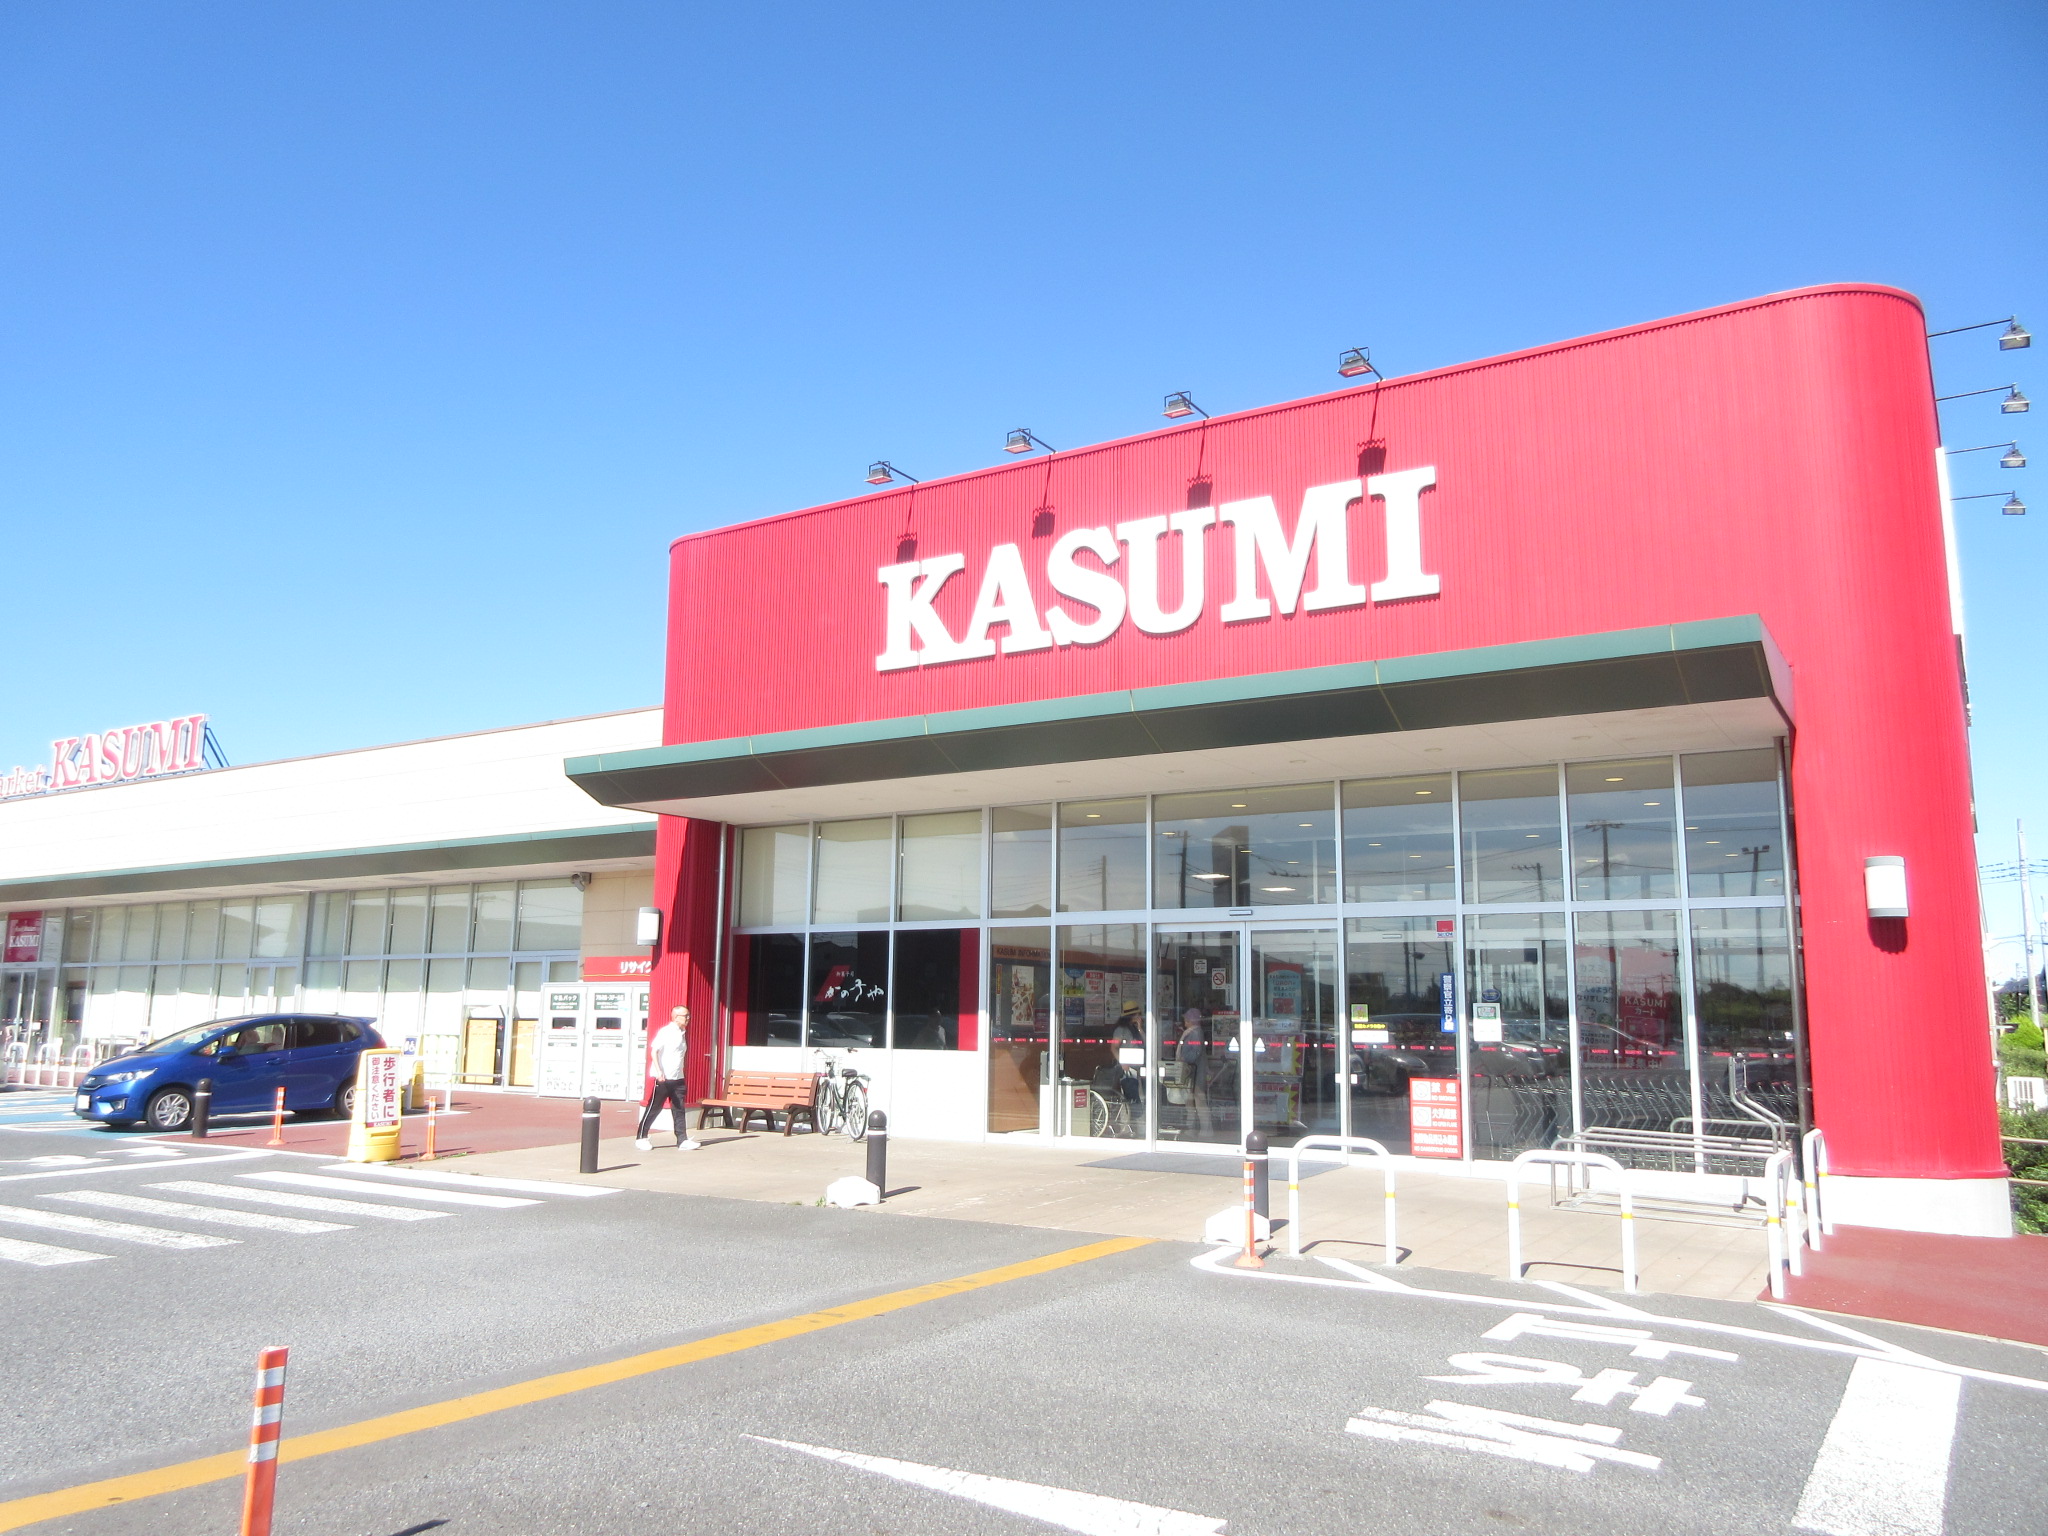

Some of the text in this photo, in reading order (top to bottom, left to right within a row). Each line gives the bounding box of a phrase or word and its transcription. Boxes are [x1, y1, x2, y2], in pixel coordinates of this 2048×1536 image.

[876, 466, 1440, 672] KASUMI
[50, 713, 206, 790] KASUMI
[10, 935, 40, 947] KASUMI
[1625, 996, 1667, 1008] KASUMI
[371, 1057, 380, 1119] 御注意ください
[383, 1057, 396, 1118] 歩行者に
